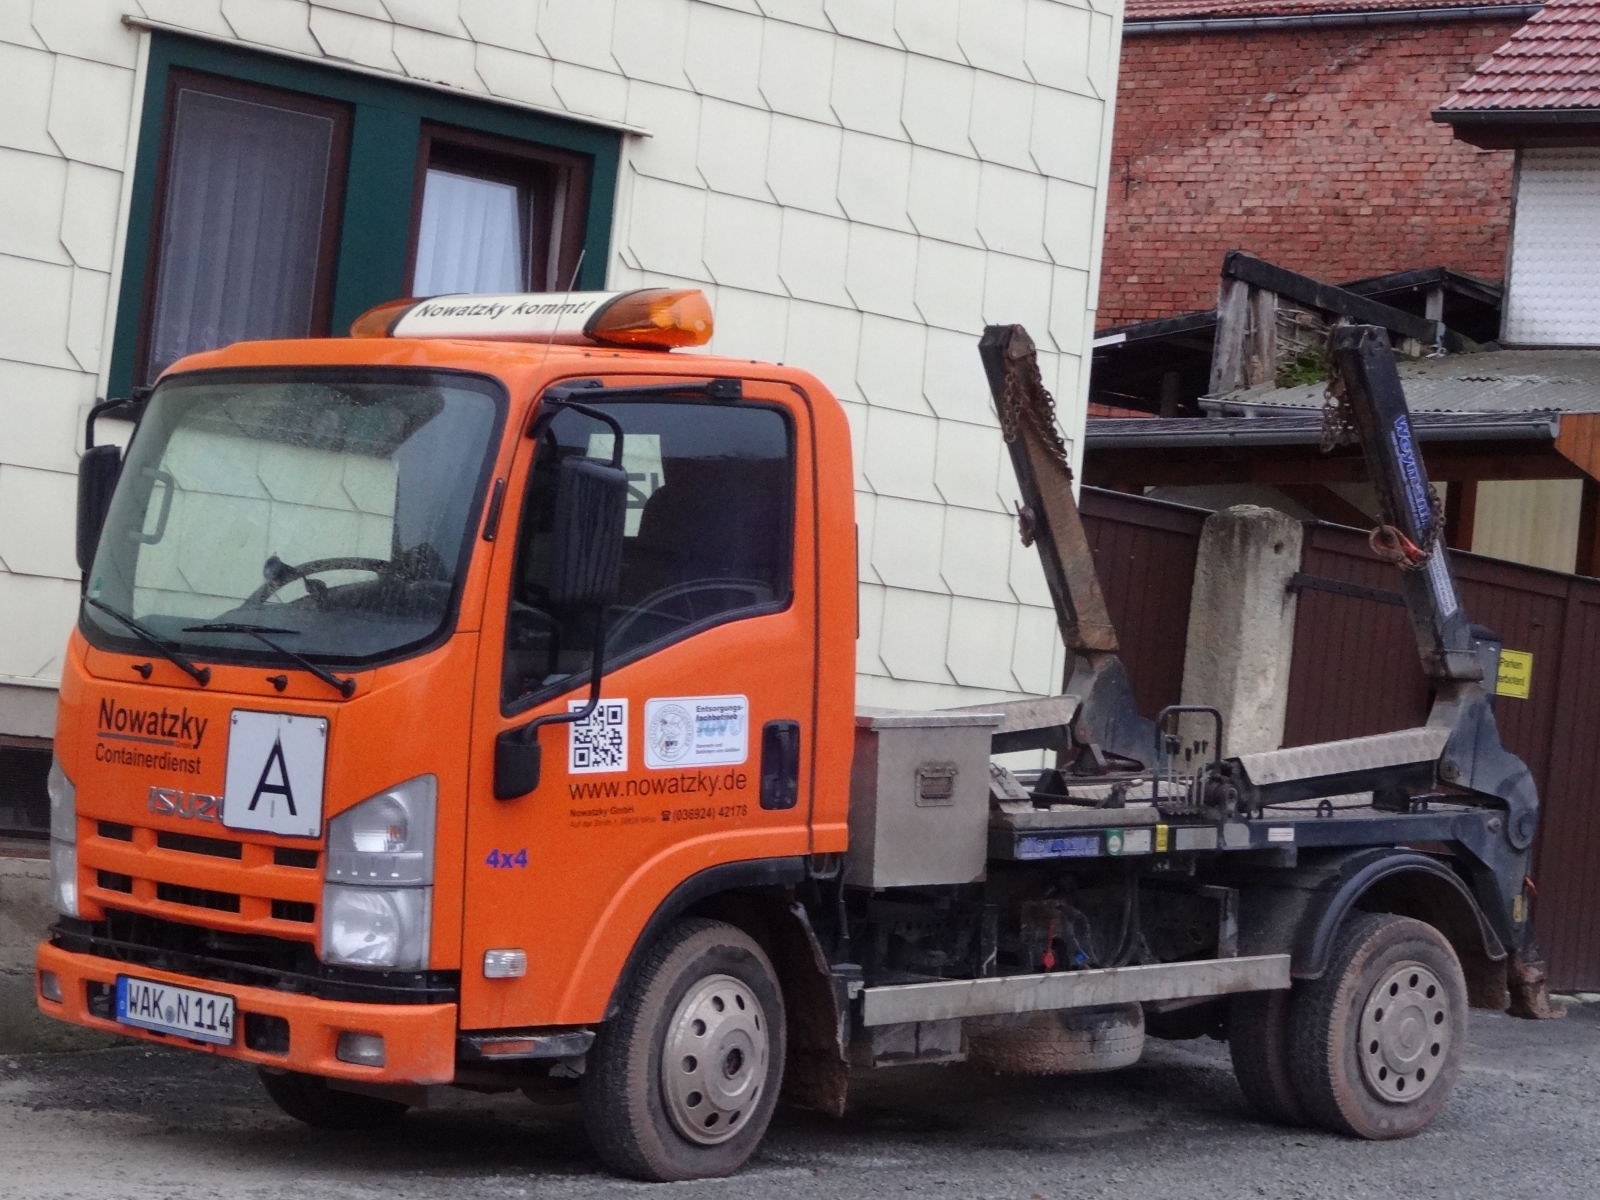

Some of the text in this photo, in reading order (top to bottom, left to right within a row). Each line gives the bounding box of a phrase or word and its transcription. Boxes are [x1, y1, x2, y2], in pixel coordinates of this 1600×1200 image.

[415, 300, 596, 320] Nowatzky kommt!
[1498, 674, 1525, 687] erboten!
[695, 705, 744, 714] Entsorgungs-
[98, 697, 208, 749] Nowatzky
[95, 743, 201, 775] Containerdienst
[248, 734, 298, 817] A
[569, 769, 748, 801] www.nowatzky.de
[569, 806, 635, 819] Nowatzky GmbH
[673, 808, 716, 824] (036924)
[485, 848, 529, 869] 4x4
[128, 983, 164, 1020] WAK
[177, 993, 189, 1026] N
[194, 997, 231, 1033] 114
